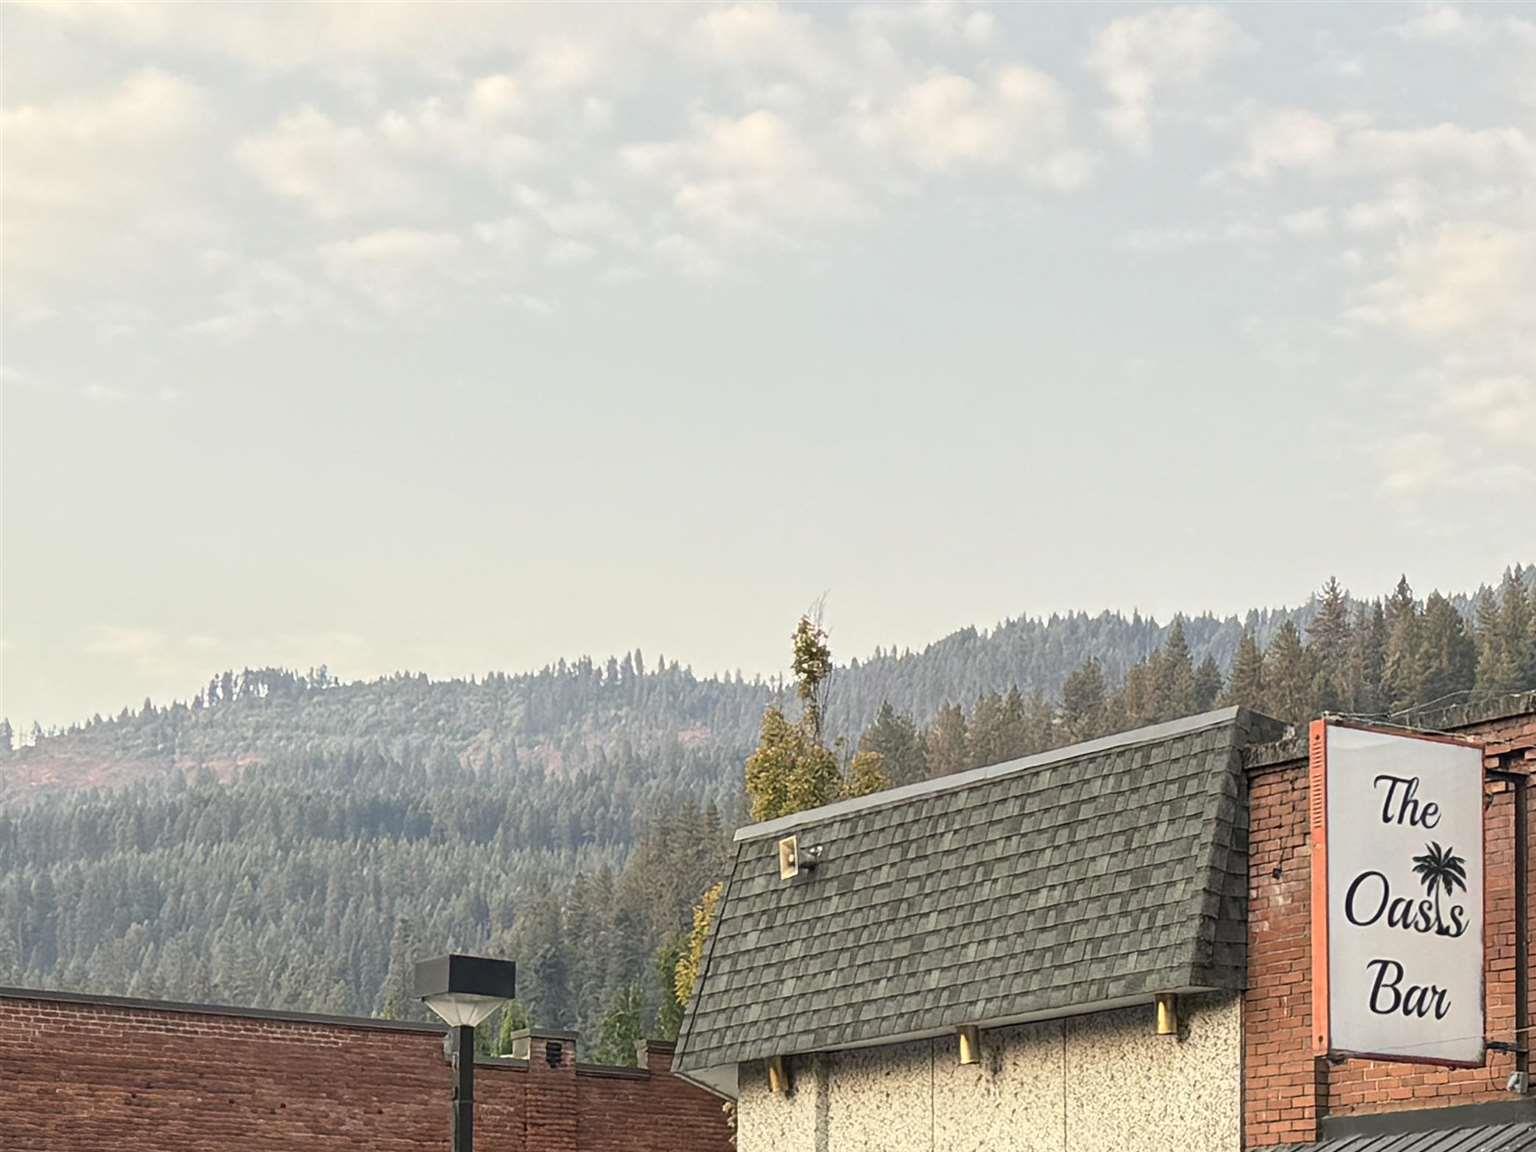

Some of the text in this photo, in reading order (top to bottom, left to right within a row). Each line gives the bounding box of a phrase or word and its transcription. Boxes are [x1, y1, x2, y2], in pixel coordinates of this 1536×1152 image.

[1373, 774, 1442, 830] The
[1344, 870, 1471, 939] Oasis
[1366, 958, 1451, 1021] Bar
